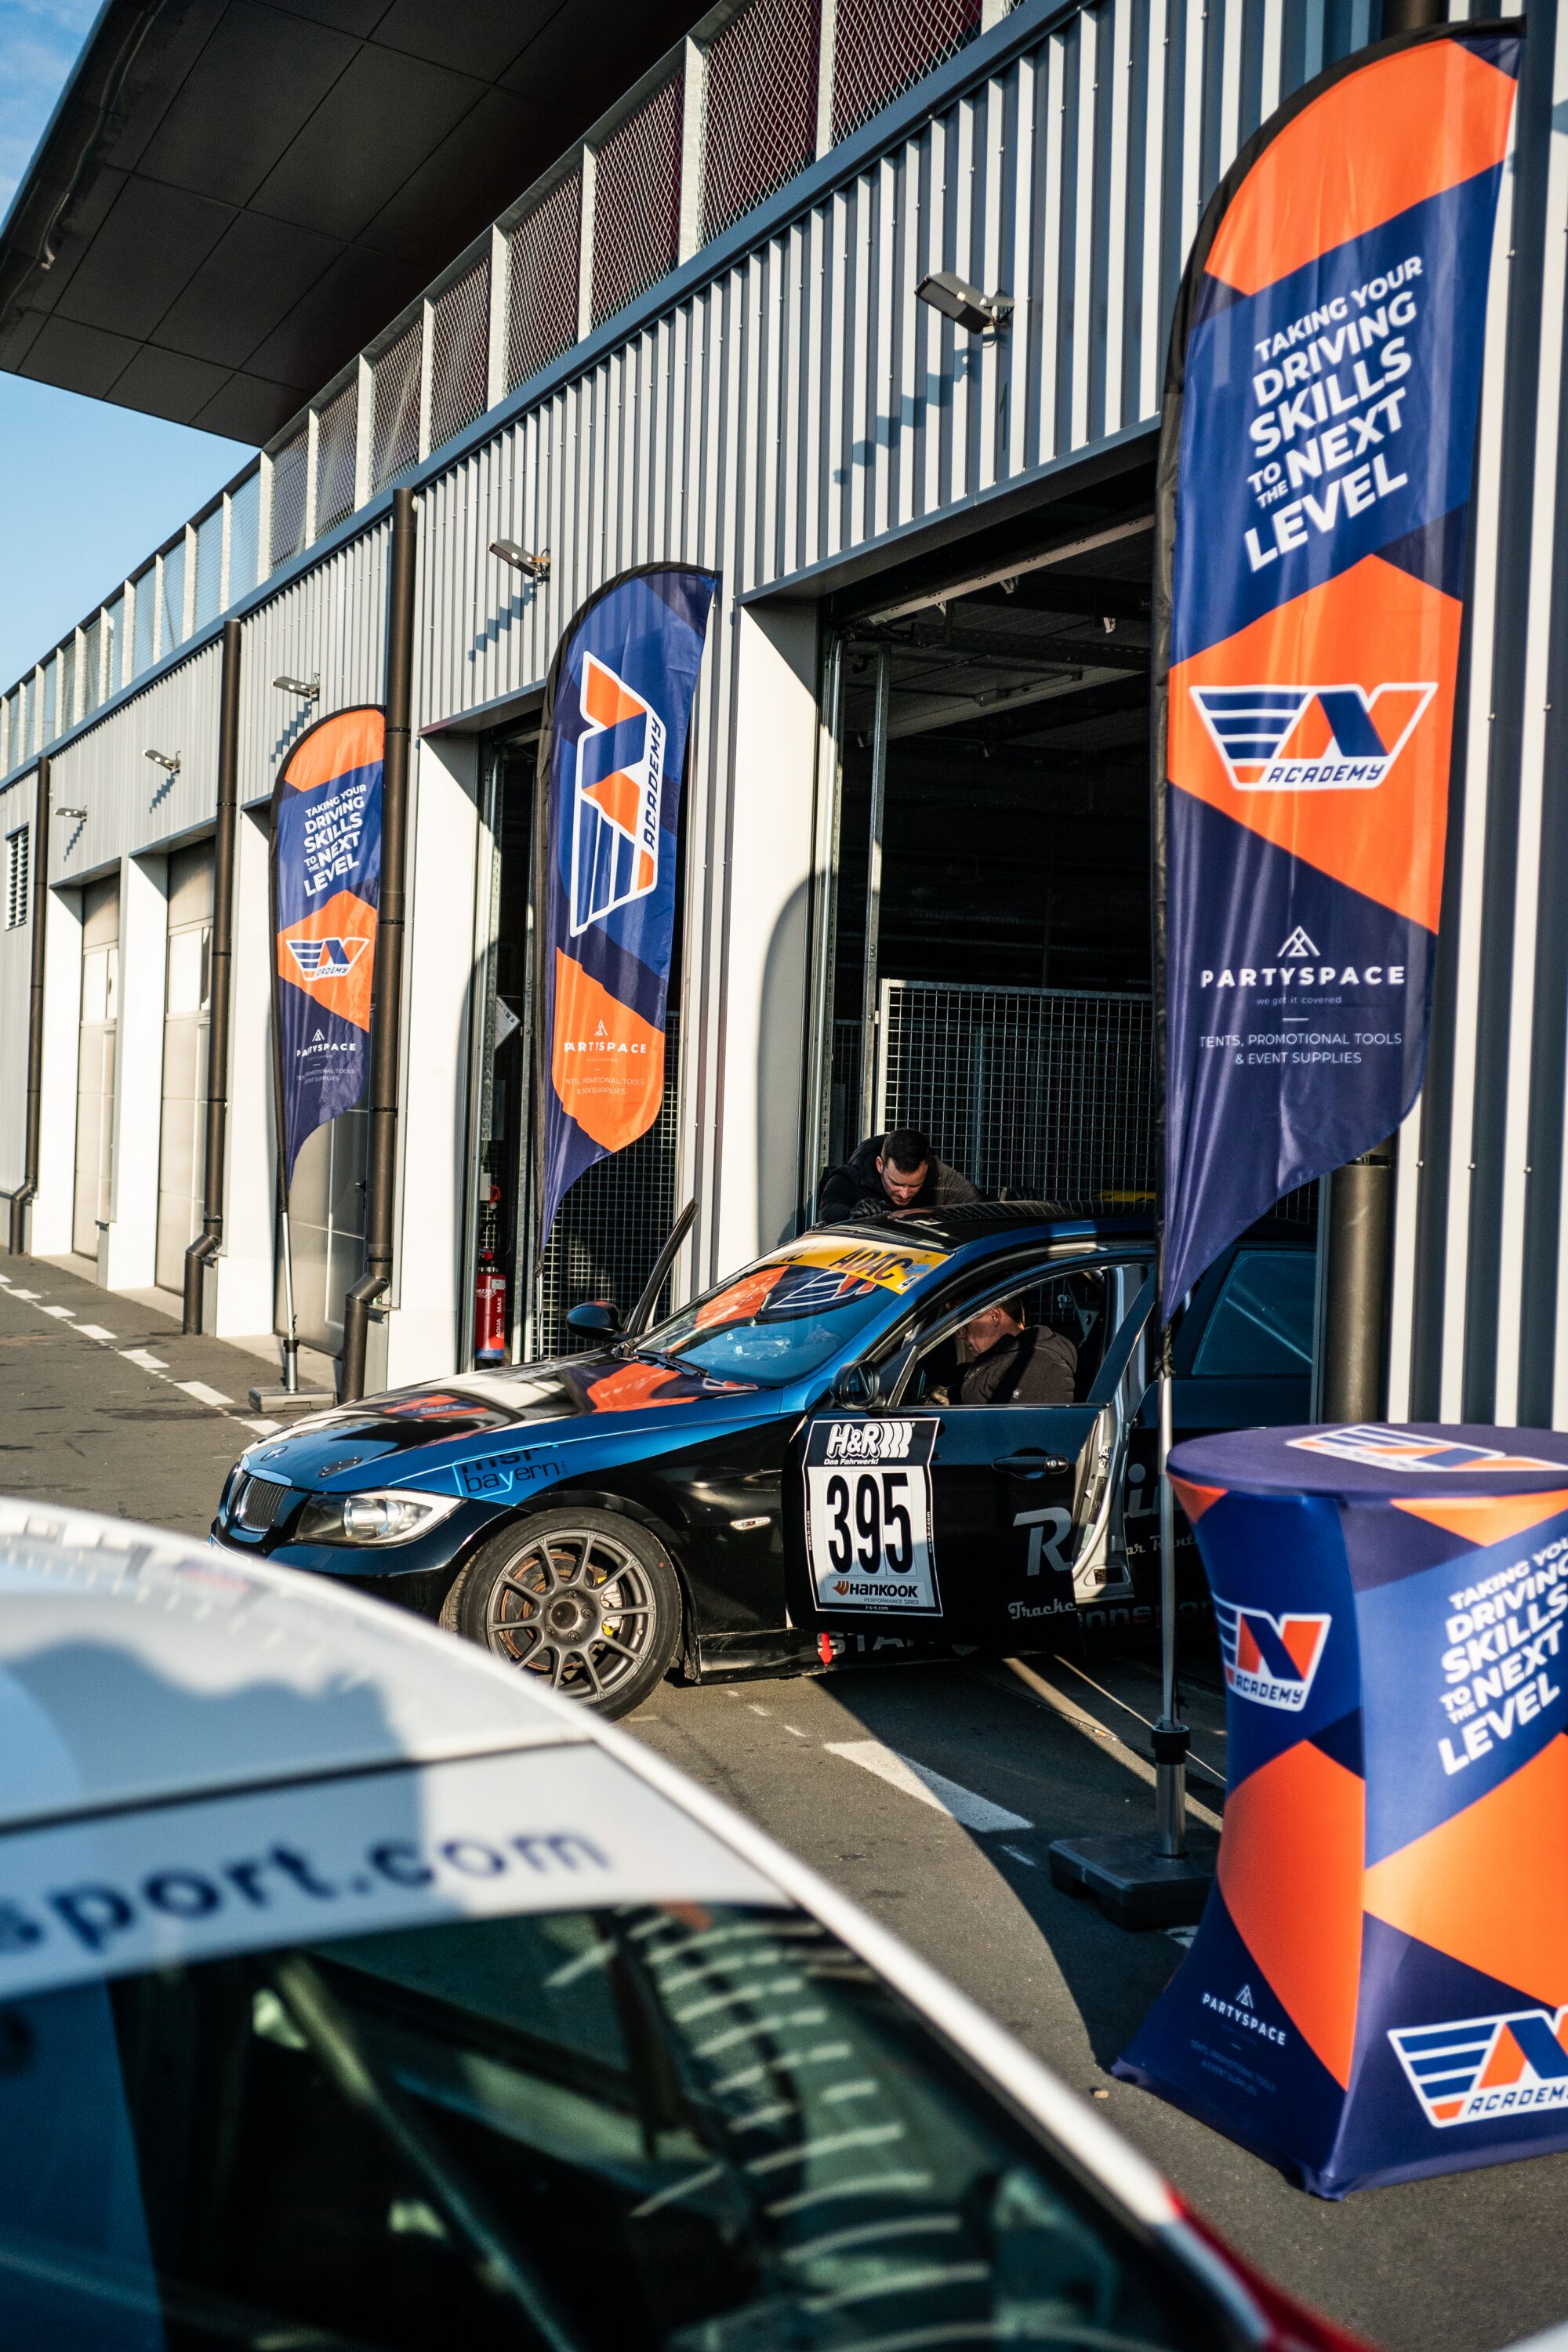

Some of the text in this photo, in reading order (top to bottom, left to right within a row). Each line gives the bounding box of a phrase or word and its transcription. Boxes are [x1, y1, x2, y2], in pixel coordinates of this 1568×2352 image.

[1254, 256, 1423, 361] TAKING YOUR
[1253, 292, 1417, 405] DRIVING
[1250, 337, 1411, 457] SKILLS
[1248, 388, 1406, 510] TO THE NEXT
[1244, 454, 1408, 572] LEVEL
[644, 716, 661, 850] ACADEMY
[1268, 763, 1385, 783] ACADEMY
[305, 784, 367, 817] TAKING YOUR
[305, 797, 365, 834] DRIVING
[304, 812, 363, 854] SKILLS
[304, 855, 317, 867] TO
[318, 831, 361, 867] NEXT
[303, 853, 360, 897] LEVEL
[1201, 967, 1404, 988] PARTYSPACE
[1272, 996, 1287, 1006] get
[1200, 1033, 1402, 1047] TENTS, PROMOTIONAL TOOLS
[1236, 1052, 1362, 1064] & EVENT SUPPLIES
[828, 1247, 913, 1280] ADAC
[827, 1423, 883, 1458] H&R
[464, 1461, 560, 1493] bayern
[826, 1472, 913, 1574] 395
[1449, 1560, 1530, 1610] TAKING
[1441, 1583, 1568, 1683] SKILLS
[1236, 1675, 1304, 1704] ACADEMY
[1440, 1620, 1563, 1724] TO THE NEXT
[1437, 1672, 1560, 1776] LEVEL
[1202, 1992, 1287, 2045] PARTYSPACE
[1468, 2085, 1568, 2115] ACADEM
